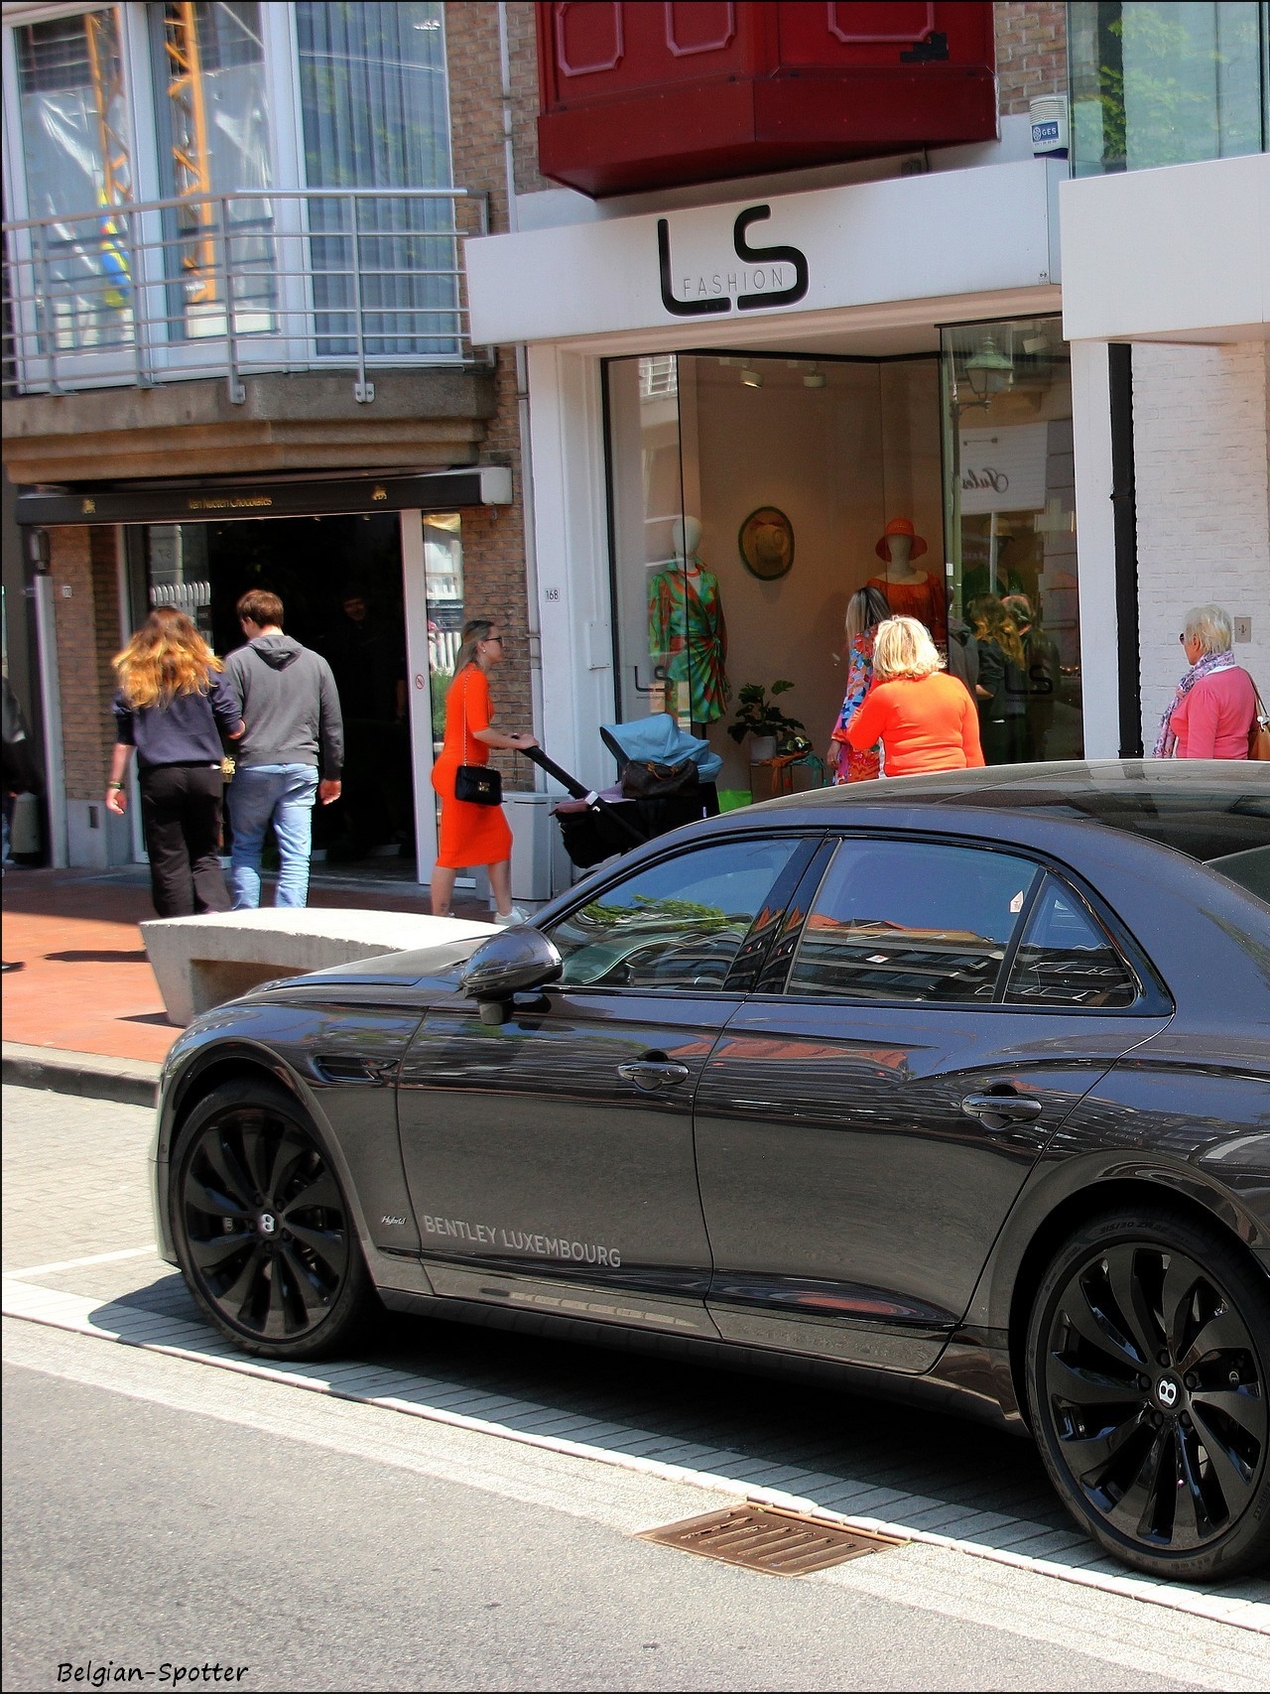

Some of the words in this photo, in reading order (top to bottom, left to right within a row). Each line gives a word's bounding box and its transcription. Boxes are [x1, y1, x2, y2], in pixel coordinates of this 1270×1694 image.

[1041, 127, 1057, 136] GES
[657, 204, 809, 317] LS
[683, 267, 784, 298] FASHION
[546, 590, 558, 600] 168
[381, 1215, 407, 1226] Hybrid
[424, 1215, 497, 1244] BENTLEY
[502, 1229, 621, 1268] LUXEMBOURG
